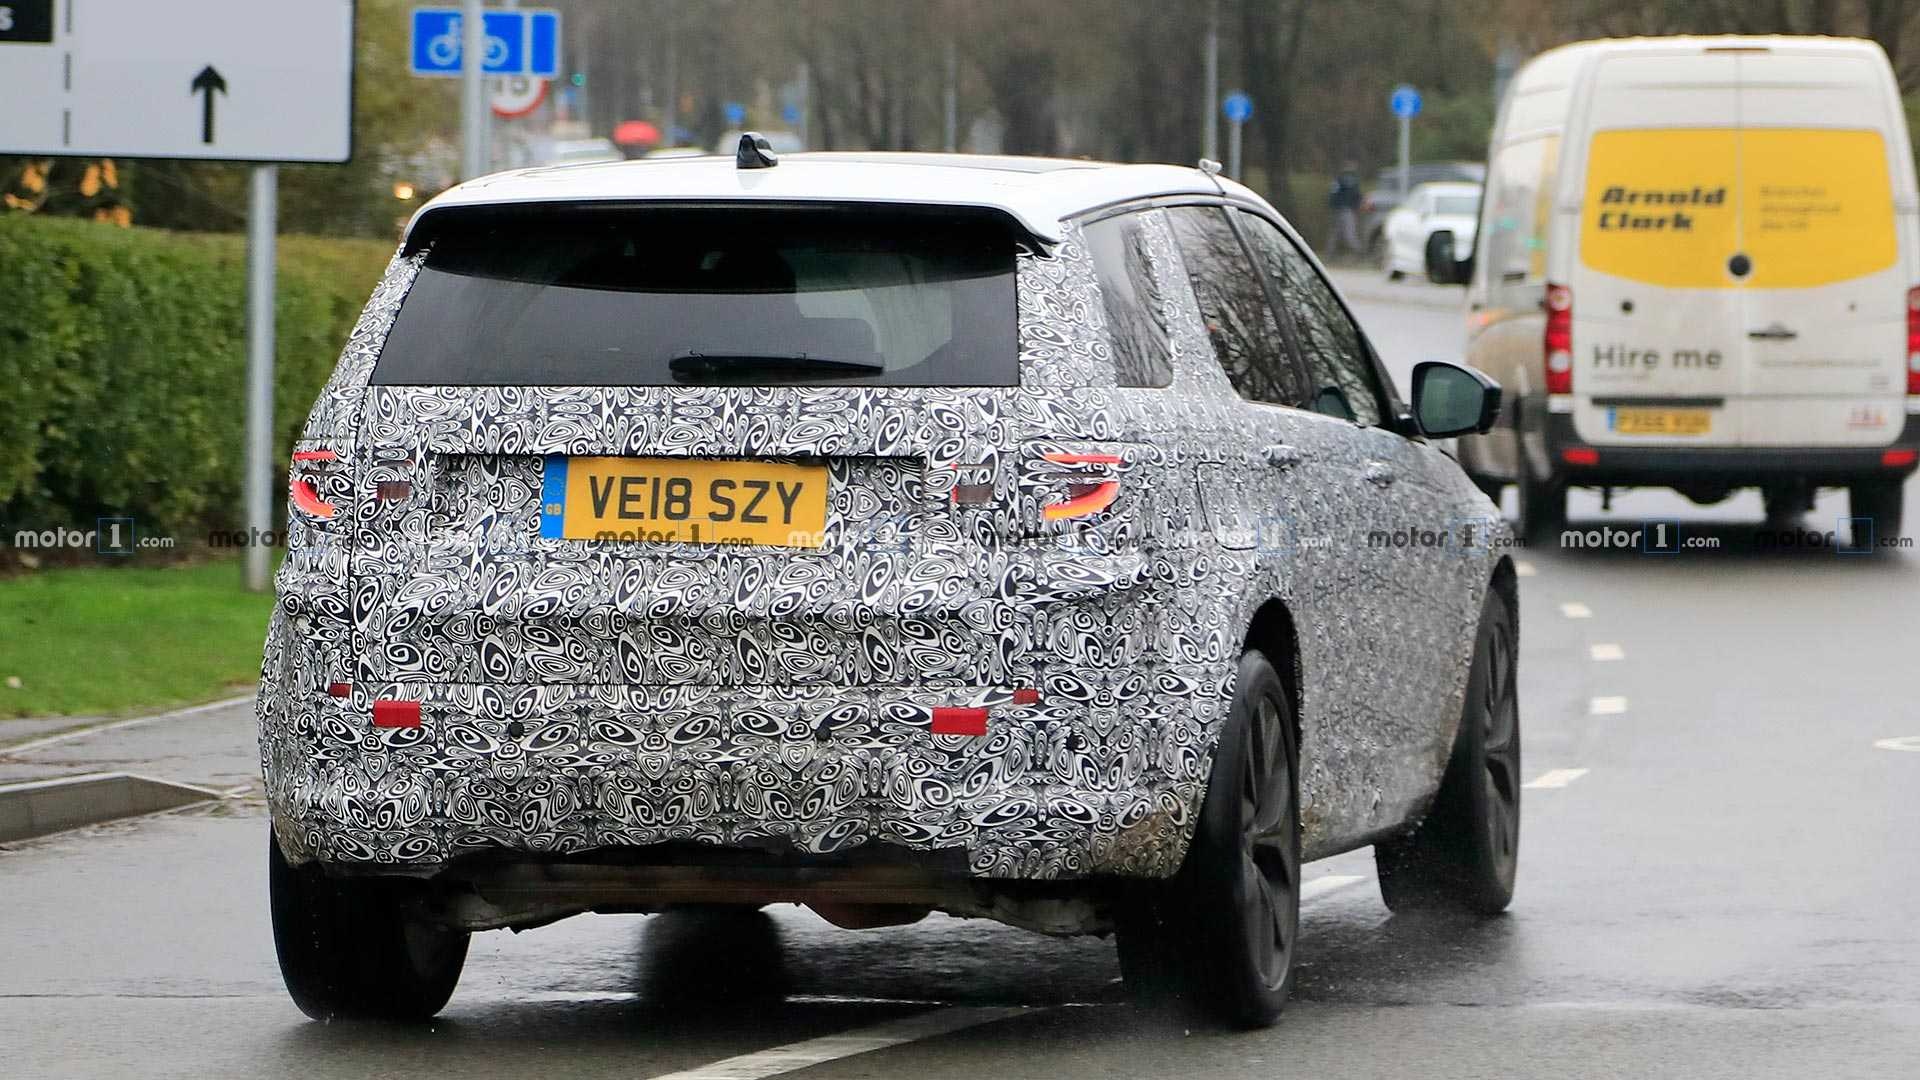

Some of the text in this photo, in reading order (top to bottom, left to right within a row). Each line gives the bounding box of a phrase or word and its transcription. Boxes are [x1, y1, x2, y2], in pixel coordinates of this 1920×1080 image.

[1600, 186, 1726, 205] Arnold
[1598, 212, 1693, 230] Clark
[1592, 344, 1723, 369] Hire me
[545, 503, 562, 516] GB
[588, 474, 805, 526] VE18 SZY
